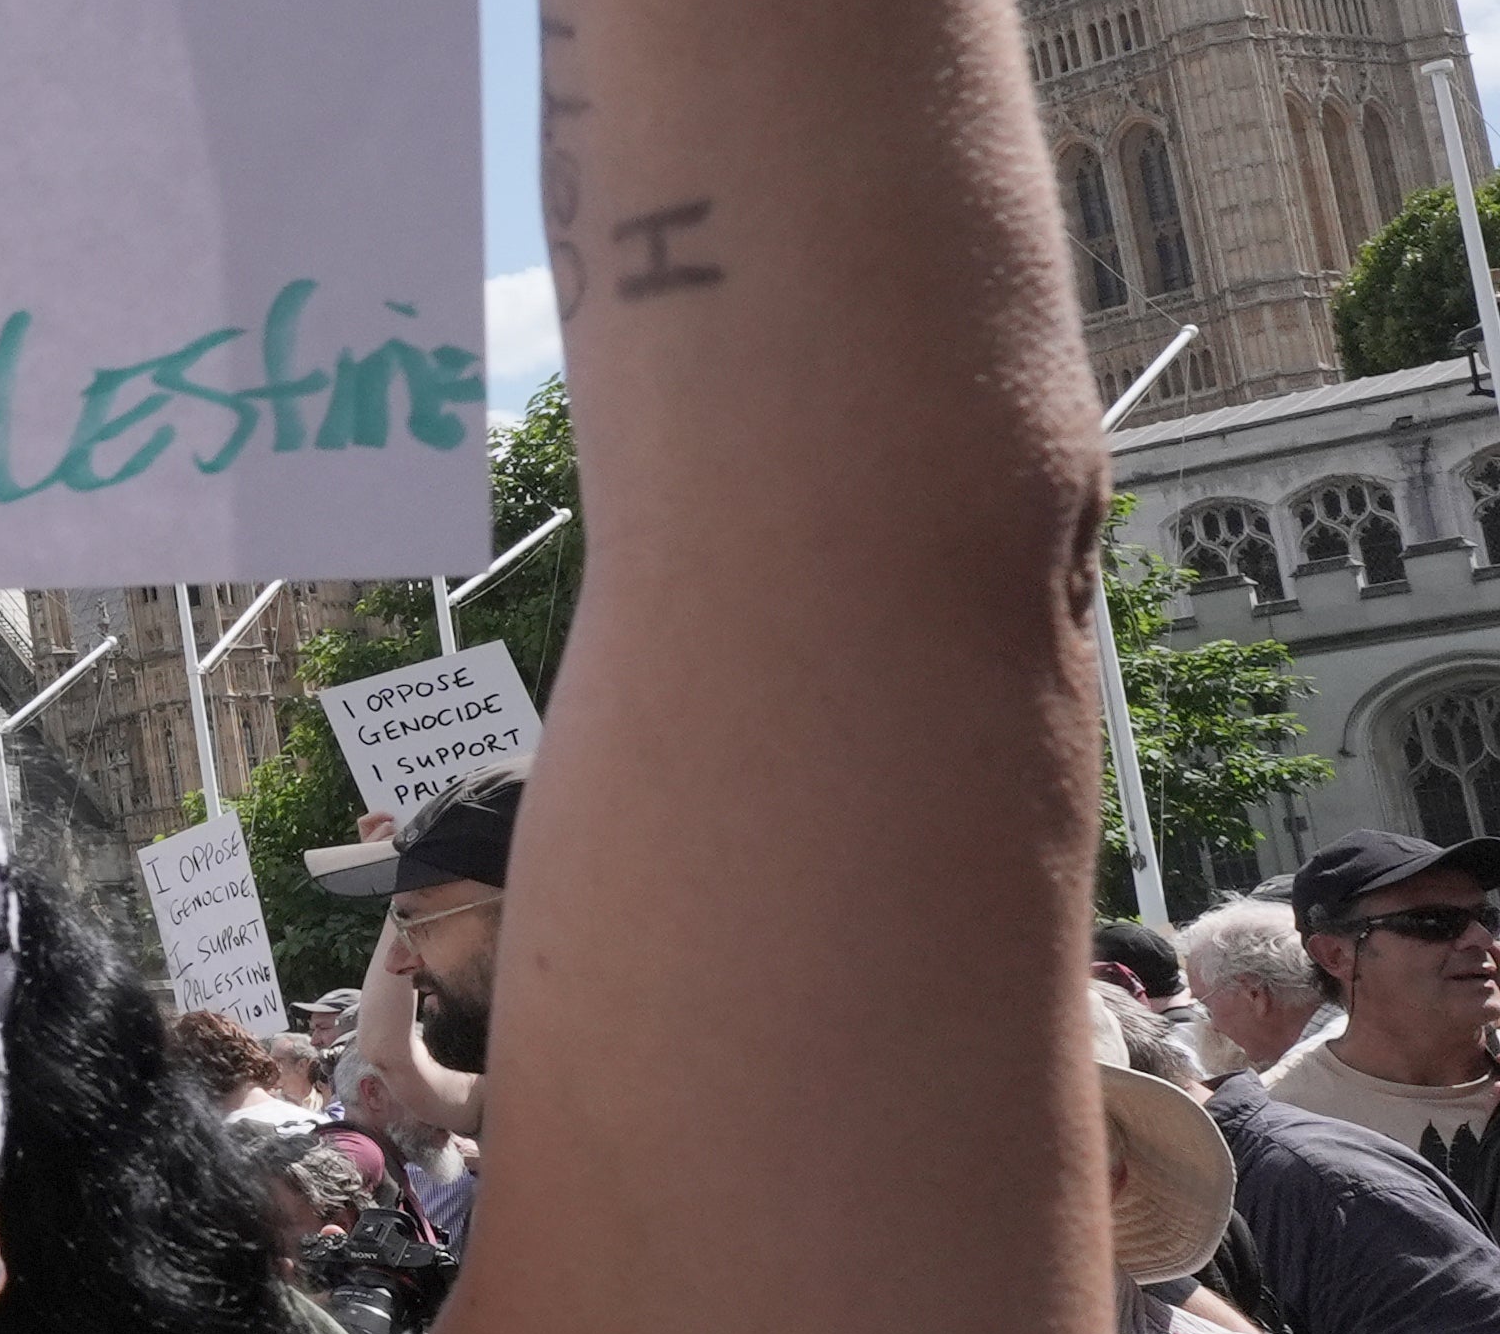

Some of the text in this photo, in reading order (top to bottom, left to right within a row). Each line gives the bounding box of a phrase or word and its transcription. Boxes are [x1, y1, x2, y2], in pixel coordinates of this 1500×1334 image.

[342, 667, 474, 719] I OPPOSE
[358, 693, 503, 746] GENOCIDE
[372, 728, 520, 782] I SUPPORT
[146, 830, 243, 895] I OPPOSE
[169, 919, 260, 979] I SUPPORT
[183, 961, 271, 1013] PALESTINE
[220, 989, 278, 1025] TION
[350, 1251, 378, 1260] SONY
